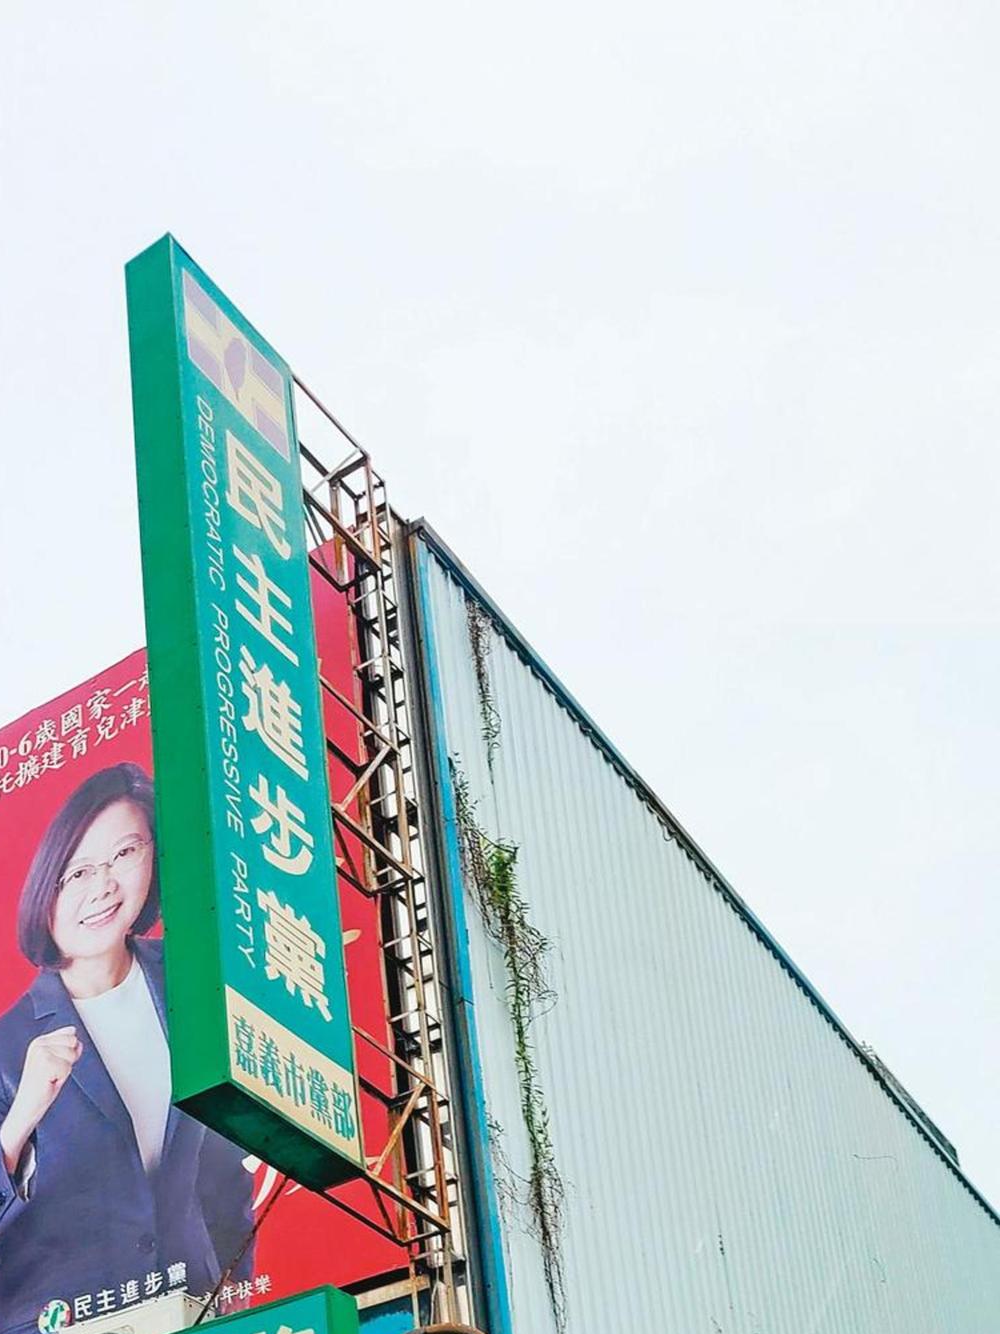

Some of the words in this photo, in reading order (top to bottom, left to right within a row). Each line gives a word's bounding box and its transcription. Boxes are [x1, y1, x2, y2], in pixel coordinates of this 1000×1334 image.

[197, 395, 226, 592] DEMOCRATIC
[210, 603, 245, 839] PROGRESSIVE
[224, 429, 334, 1022] 民主進步黨
[230, 851, 256, 969] PARTY
[231, 1013, 356, 1141] 嘉義市黨部
[74, 1262, 188, 1320] 民主進步黨
